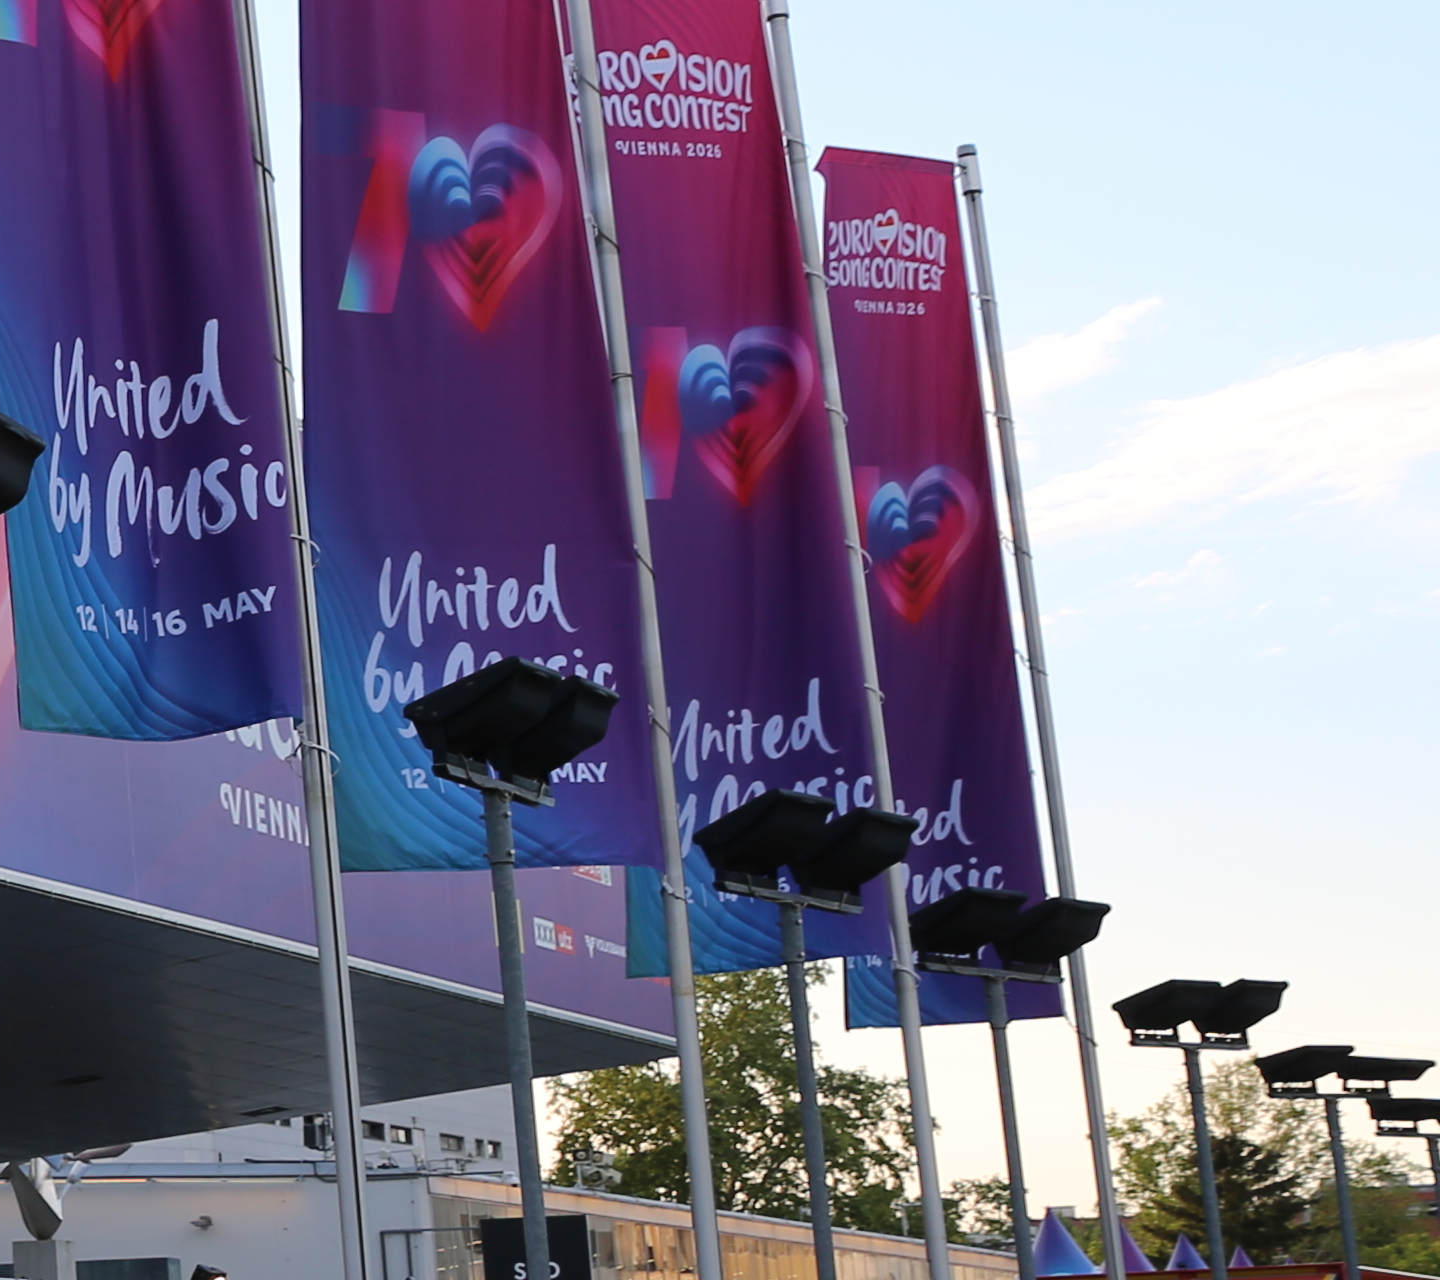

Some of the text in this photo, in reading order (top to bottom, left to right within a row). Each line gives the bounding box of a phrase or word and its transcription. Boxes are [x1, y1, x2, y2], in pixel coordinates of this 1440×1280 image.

[614, 138, 722, 160] VIENNA 2026
[52, 317, 252, 456] United
[48, 431, 288, 568] by Music
[75, 585, 278, 638] 12 14 16 MAY
[378, 543, 580, 649] United
[400, 761, 608, 790] 12 MAY
[220, 781, 311, 849] VIENN
